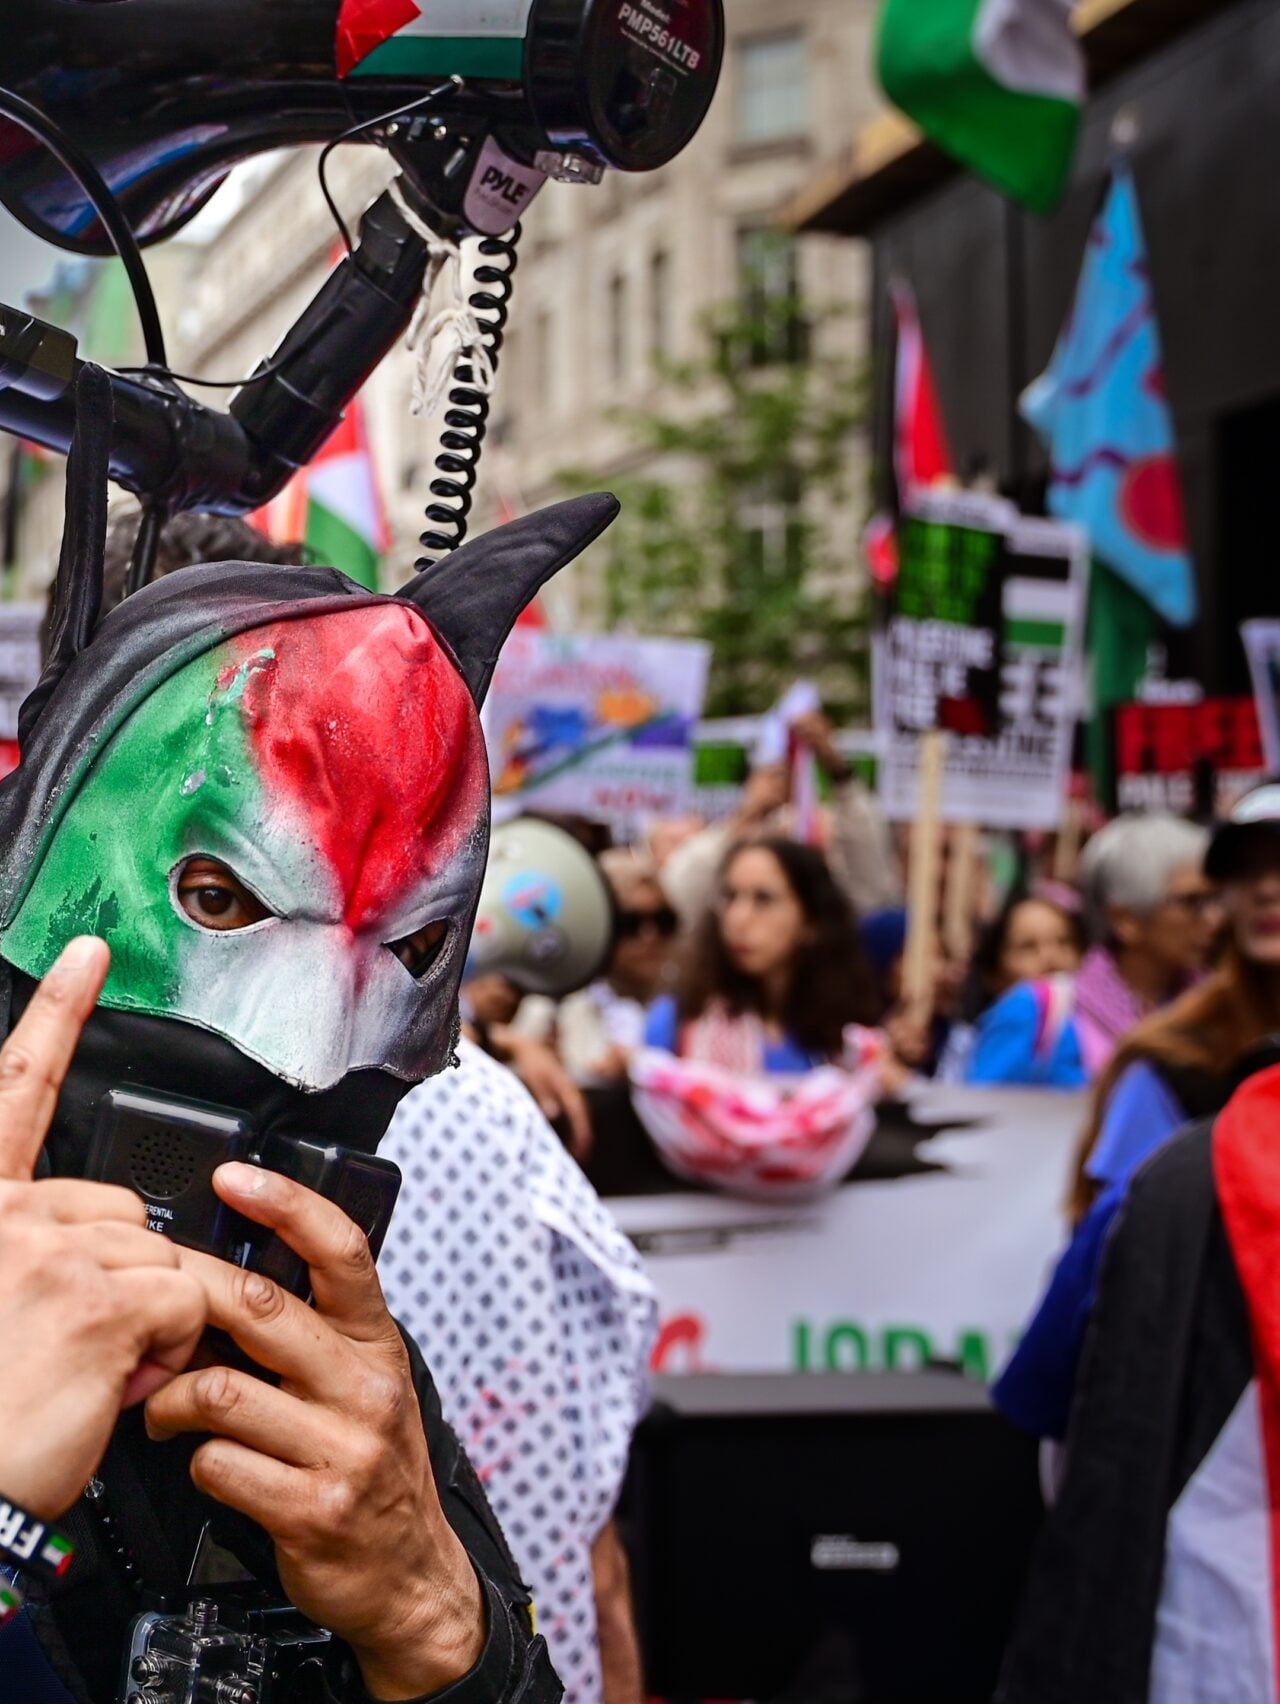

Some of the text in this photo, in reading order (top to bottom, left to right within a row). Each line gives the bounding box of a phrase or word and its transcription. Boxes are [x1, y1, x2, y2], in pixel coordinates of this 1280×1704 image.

[618, 3, 701, 69] PMP561LTB
[480, 165, 530, 205] PYLE
[144, 1204, 174, 1220] ERENTIAL
[145, 1219, 165, 1232] IKE
